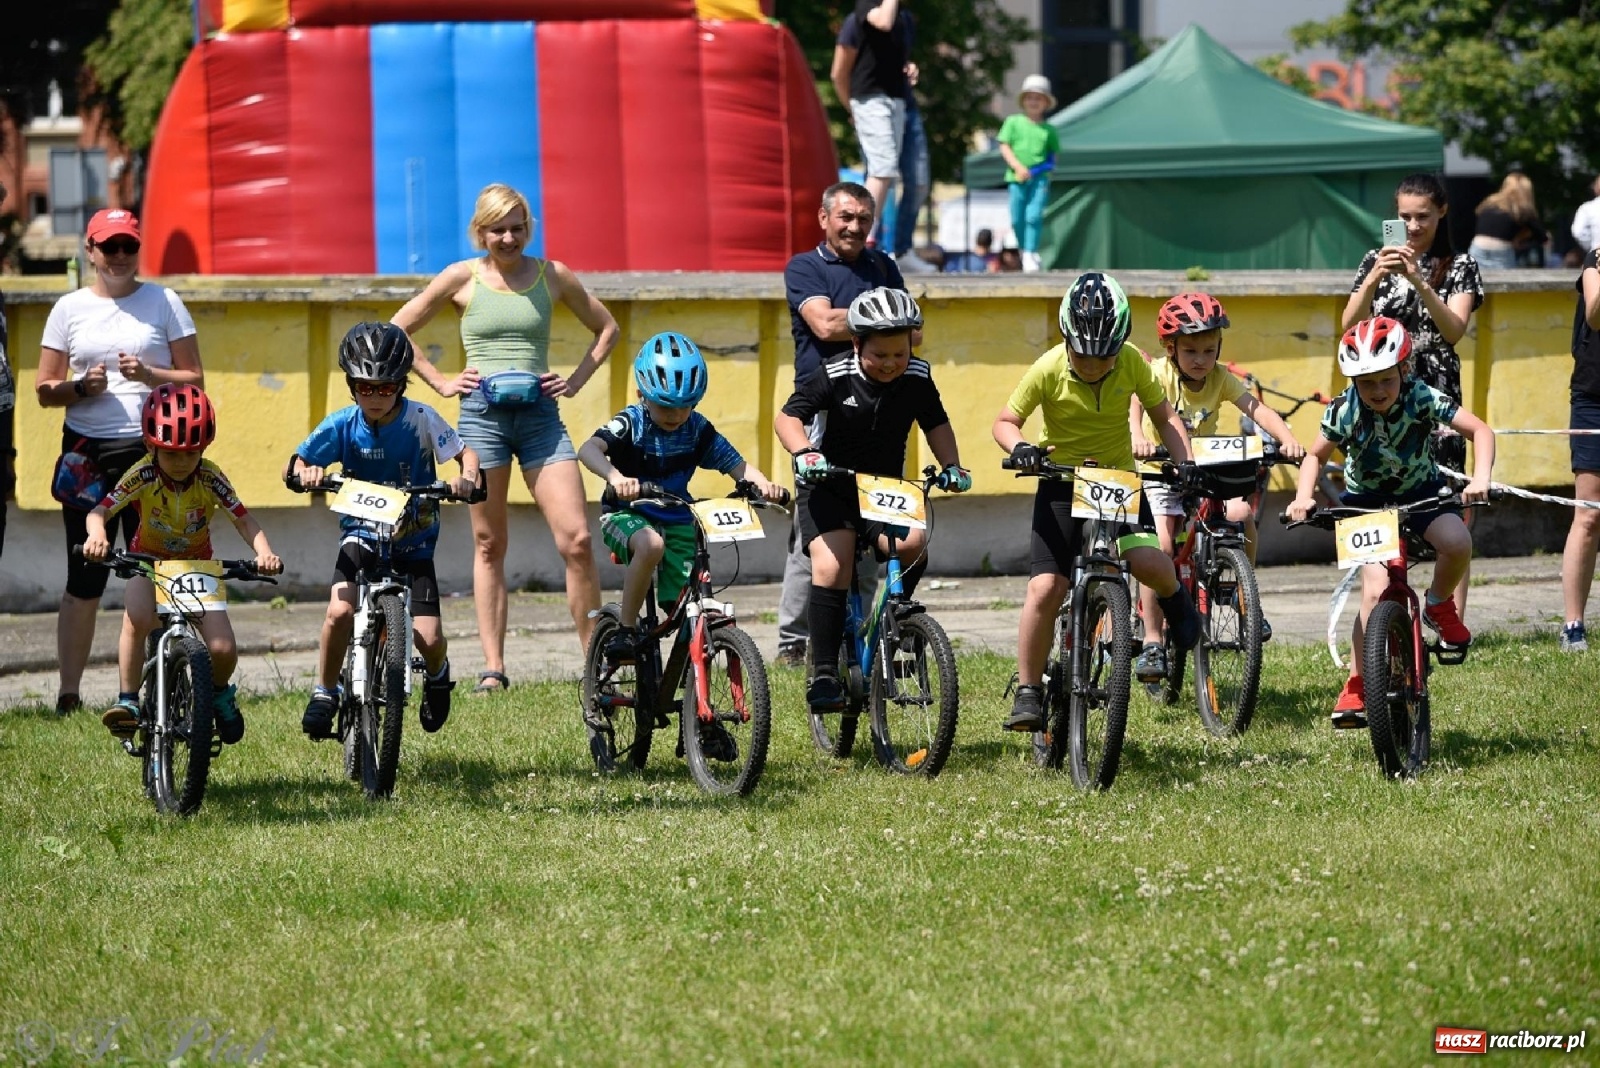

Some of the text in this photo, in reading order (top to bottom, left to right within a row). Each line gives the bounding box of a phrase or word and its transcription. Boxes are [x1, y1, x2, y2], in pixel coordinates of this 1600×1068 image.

[1210, 438, 1244, 450] 270
[353, 493, 388, 509] 160
[875, 492, 907, 510] 272
[1090, 485, 1125, 504] 078
[713, 511, 743, 526] 115
[1351, 529, 1383, 549] 011
[175, 577, 208, 594] 111
